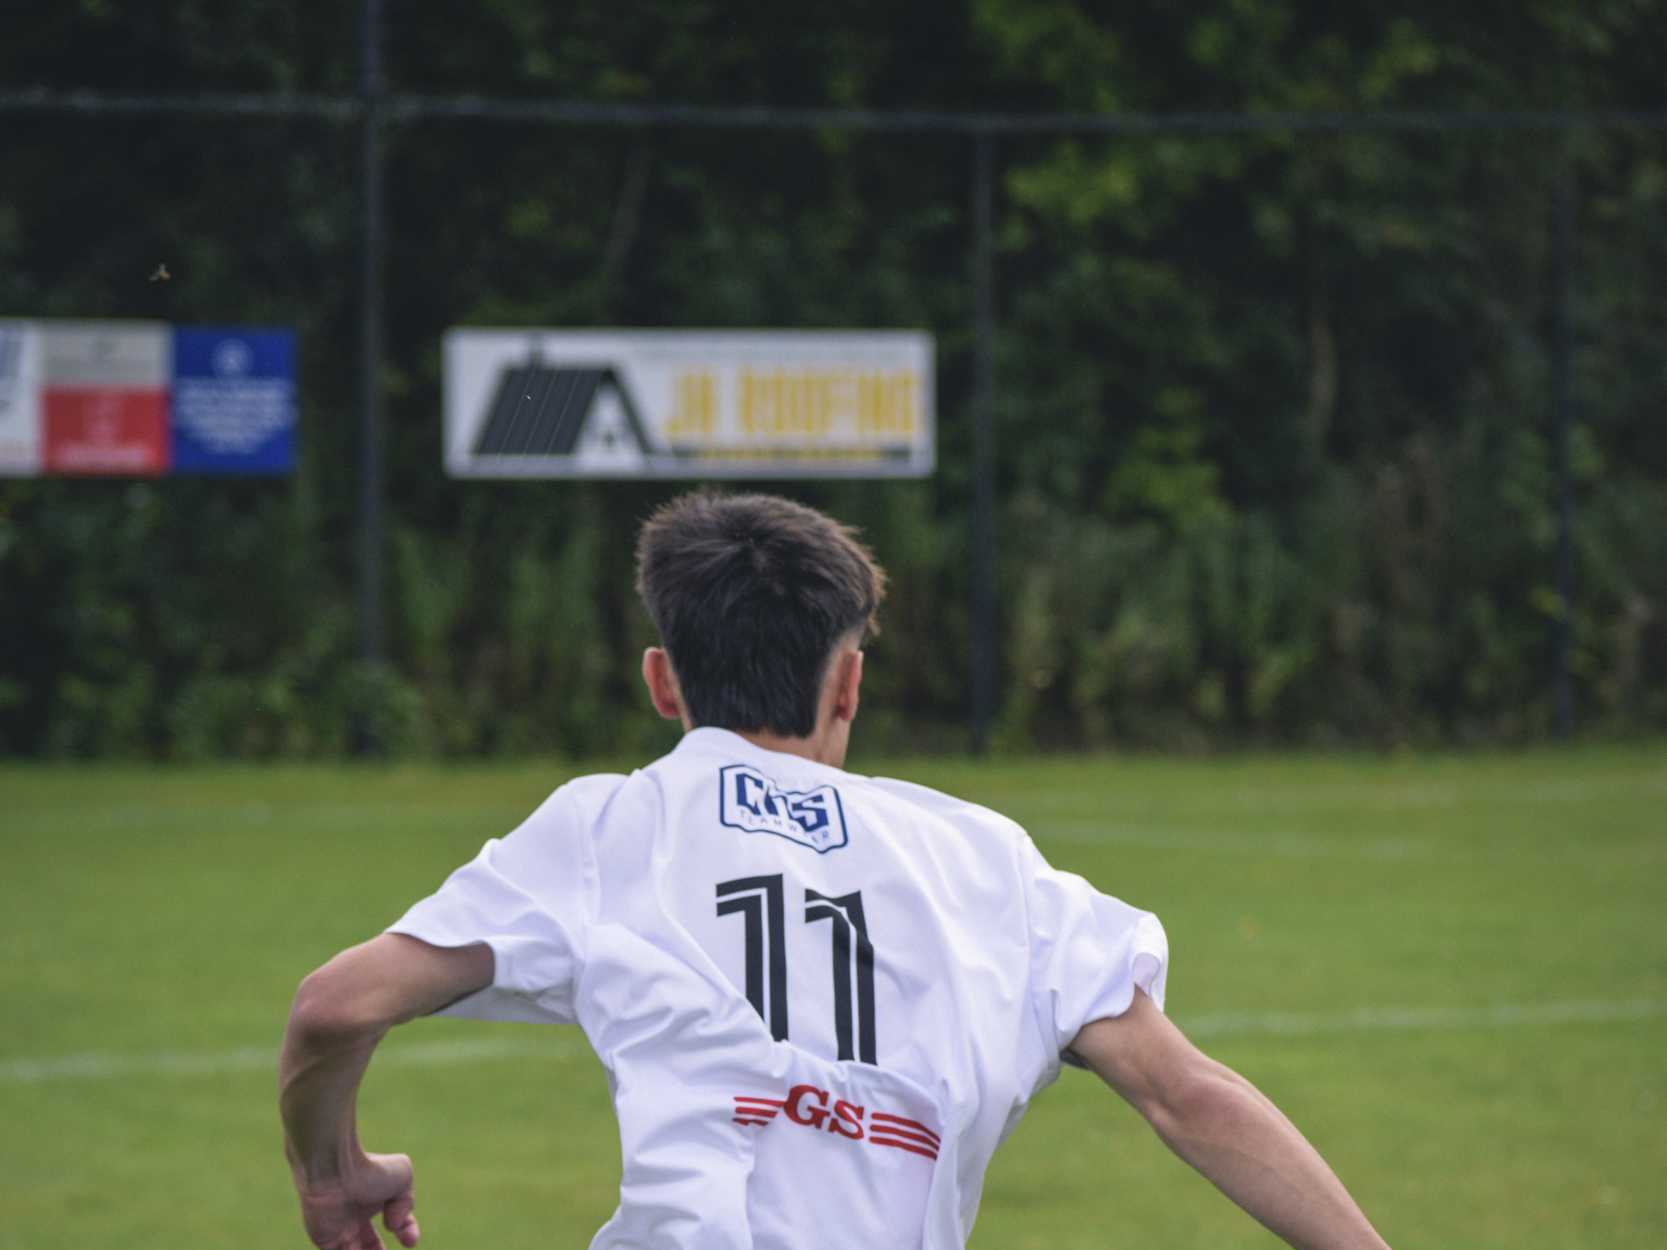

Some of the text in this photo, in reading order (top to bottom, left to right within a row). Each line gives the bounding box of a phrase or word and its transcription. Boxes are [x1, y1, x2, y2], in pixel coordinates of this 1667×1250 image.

[736, 369, 920, 437] ROOFING
[739, 809, 830, 844] TEAMWR
[715, 873, 878, 1065] 11
[783, 1084, 866, 1140] GS
